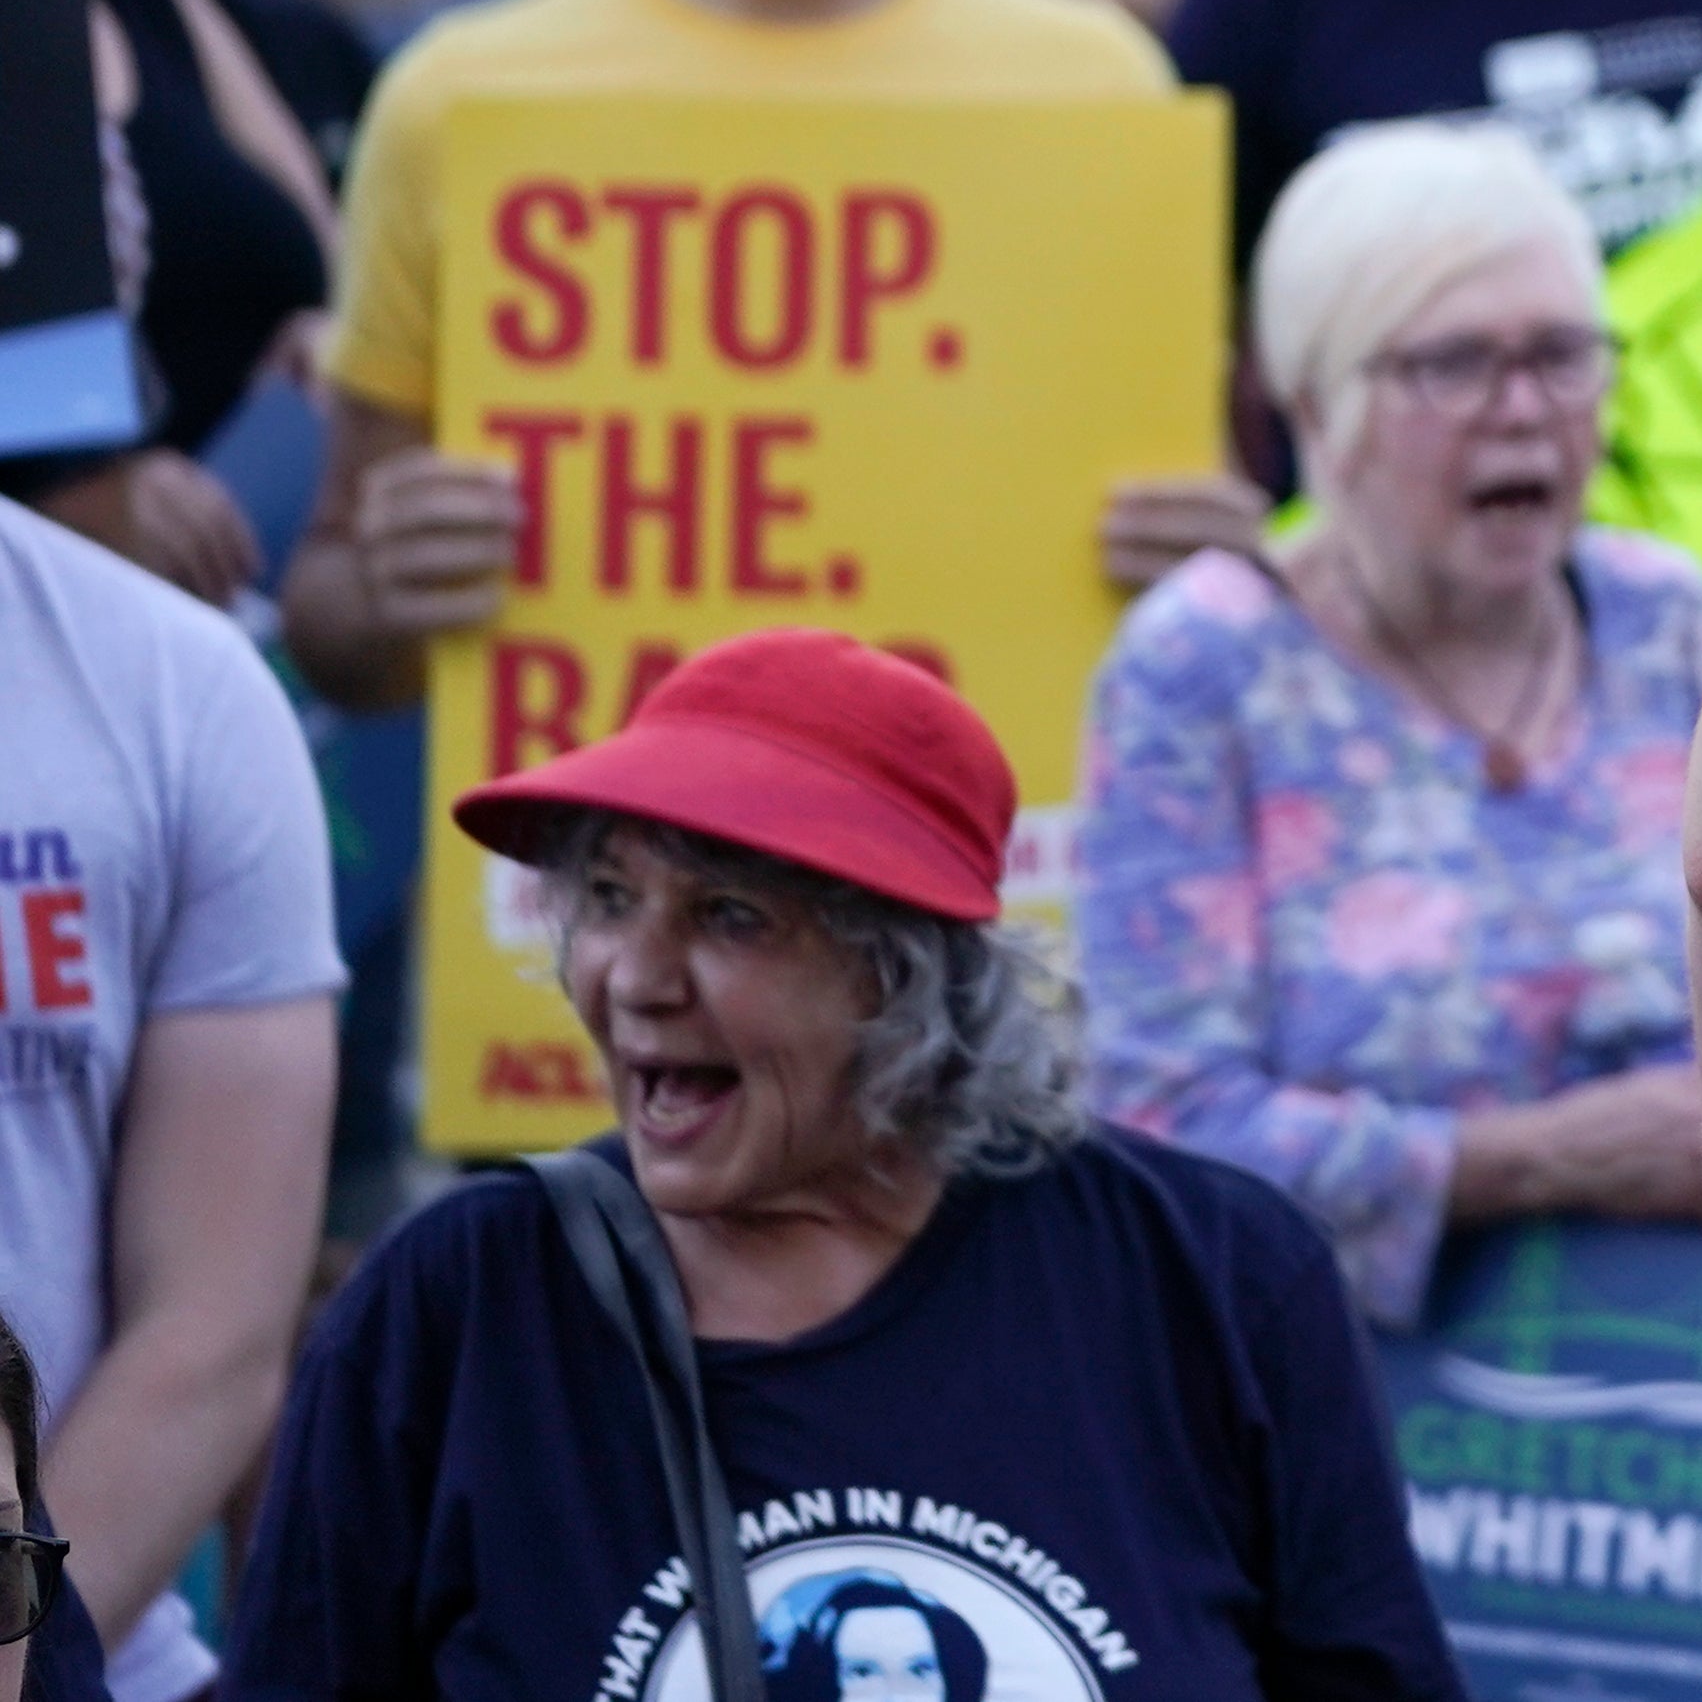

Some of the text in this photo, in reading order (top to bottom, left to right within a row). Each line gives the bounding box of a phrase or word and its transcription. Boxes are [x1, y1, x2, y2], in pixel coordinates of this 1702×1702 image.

[486, 177, 967, 373] STOP.
[481, 409, 864, 601] THE.
[643, 1488, 836, 1610] WMAN
[845, 1487, 903, 1528] IN
[911, 1496, 1140, 1673] MICHIGAN
